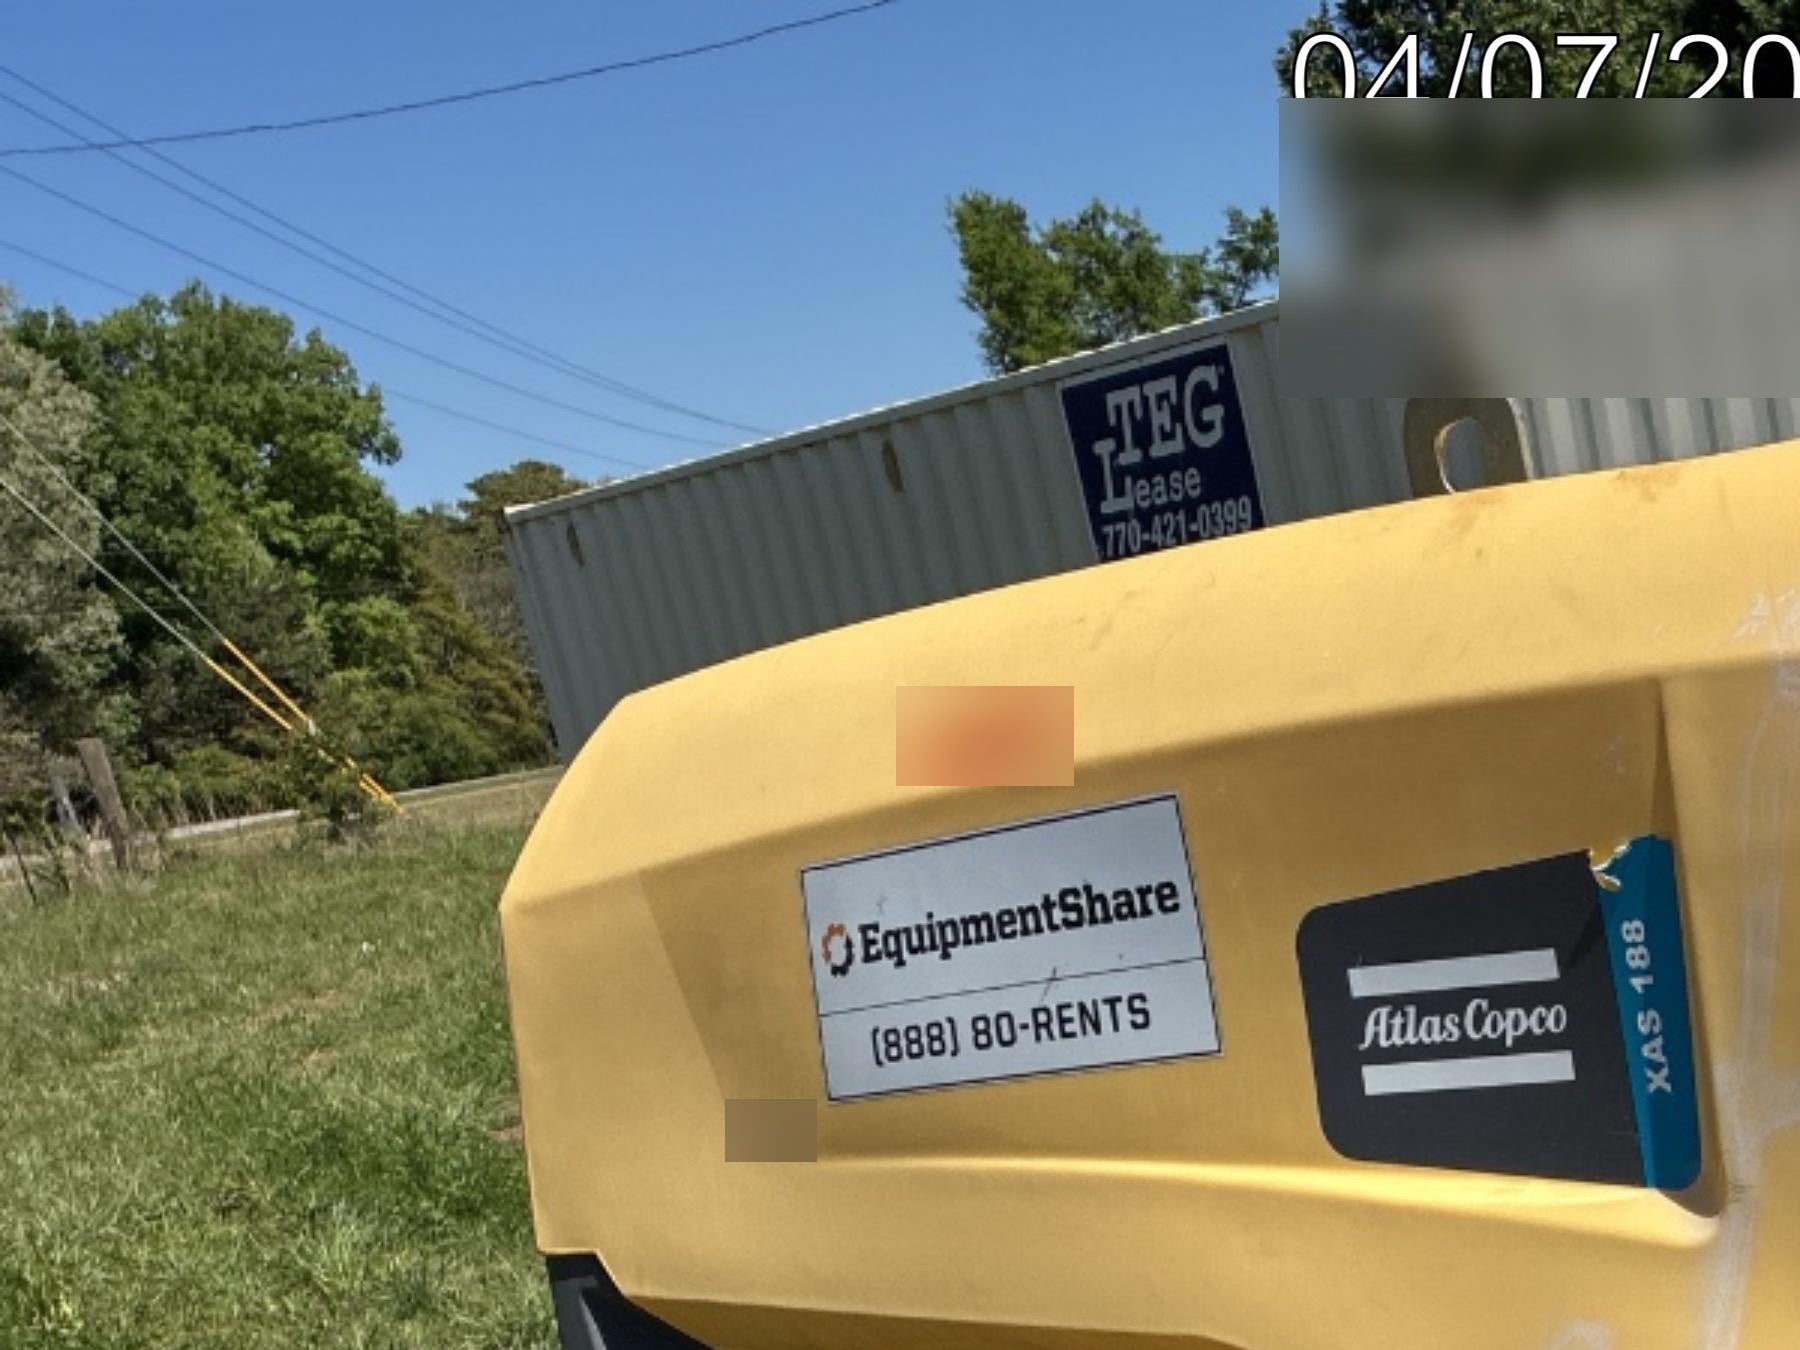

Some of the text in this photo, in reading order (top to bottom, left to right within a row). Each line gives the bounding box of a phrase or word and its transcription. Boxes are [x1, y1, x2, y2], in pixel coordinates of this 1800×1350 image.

[1105, 364, 1226, 466] TEG
[1091, 436, 1203, 515] Lease
[1101, 494, 1252, 558] 770-421-0399
[858, 879, 1181, 968] EquipmentShare
[871, 992, 1152, 1067] (888) 80-RENTS
[1620, 917, 1673, 1094] XAS 188
